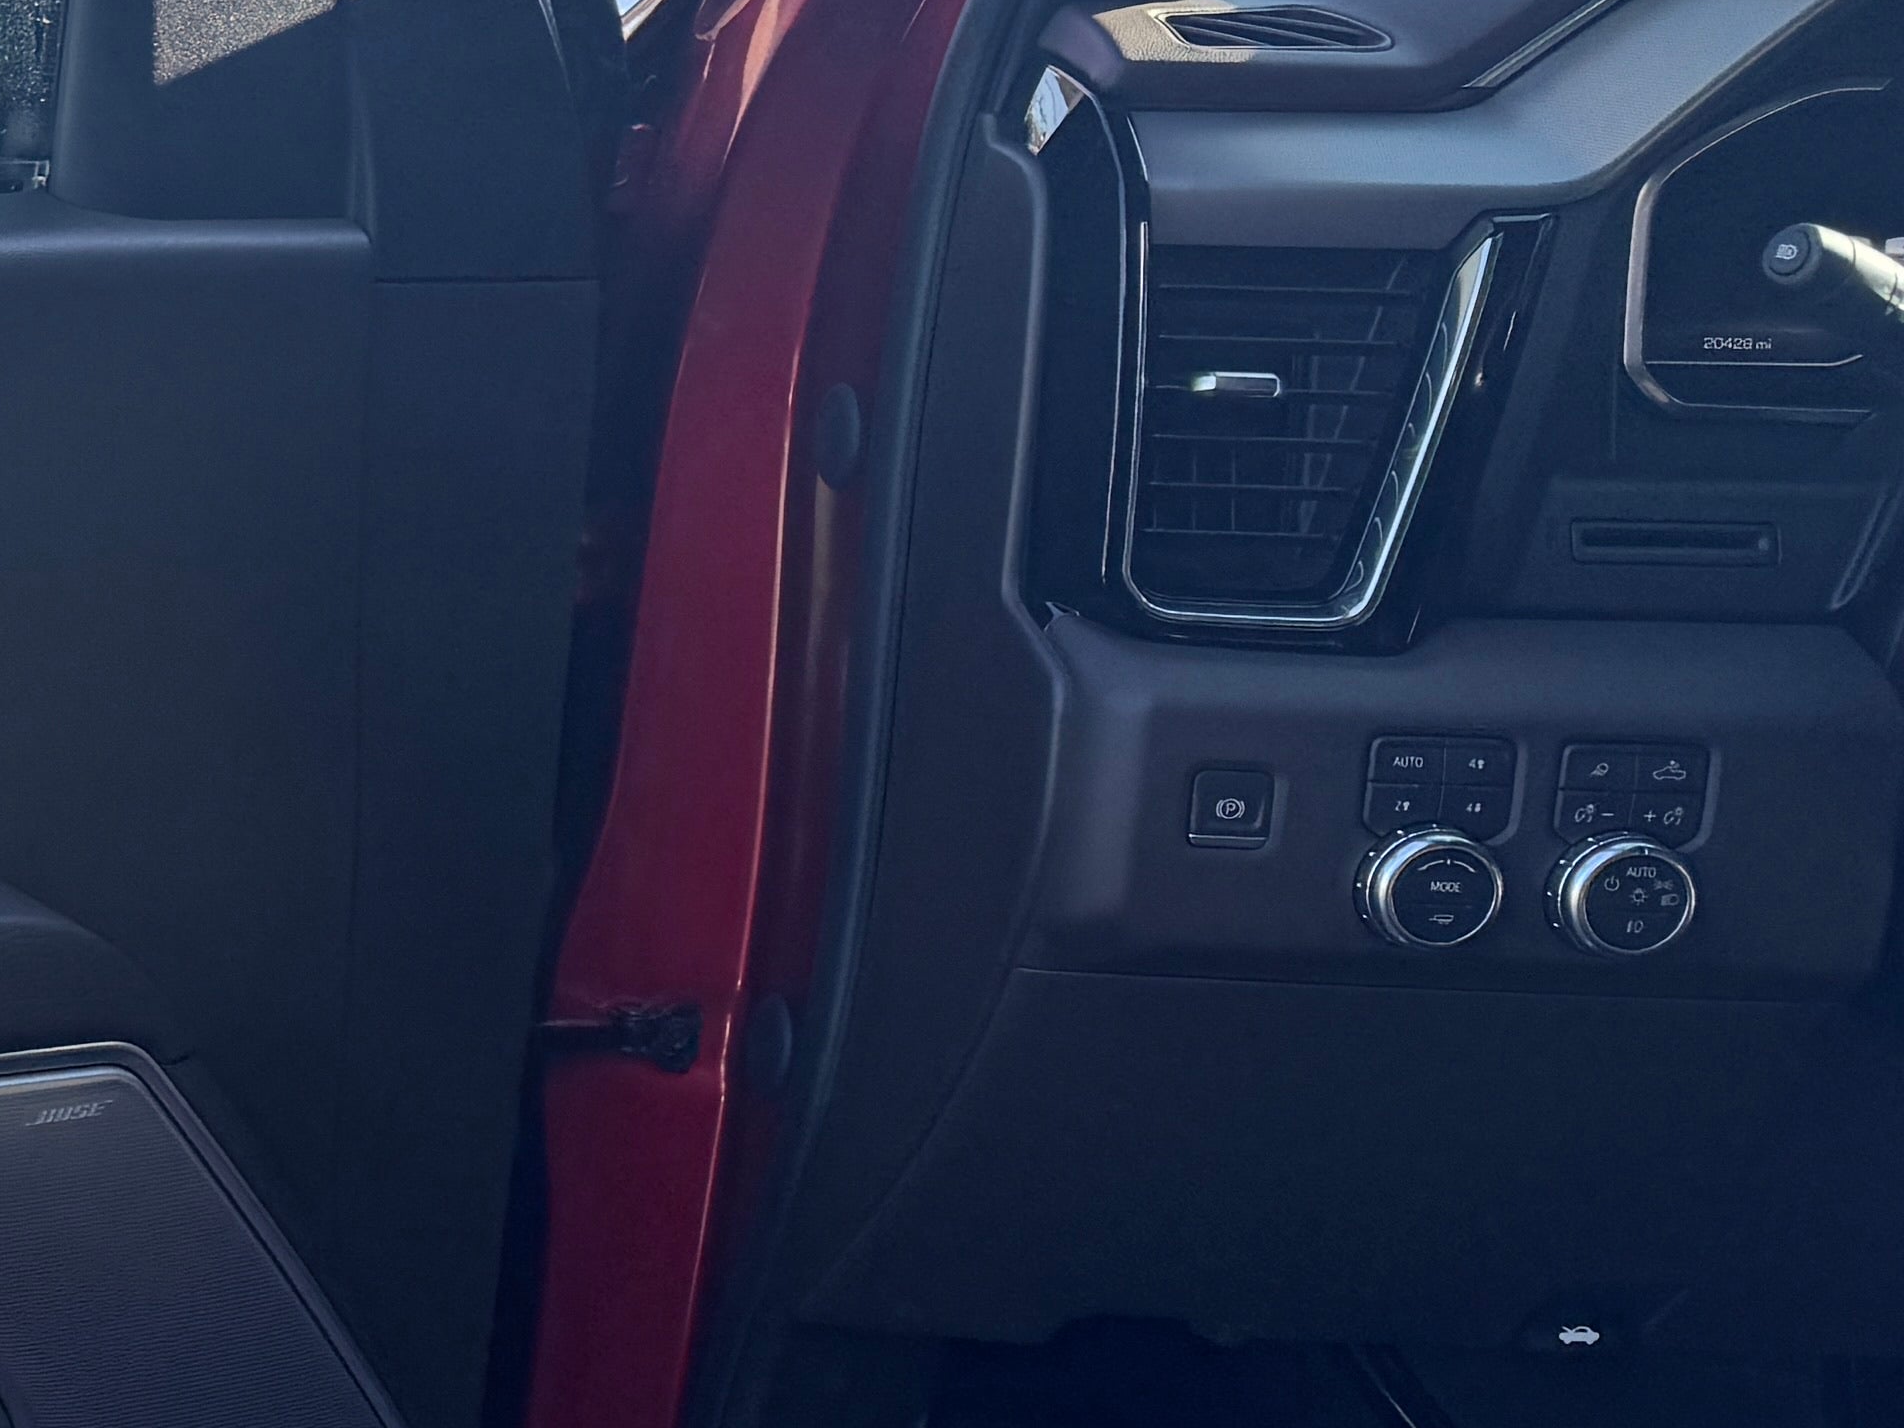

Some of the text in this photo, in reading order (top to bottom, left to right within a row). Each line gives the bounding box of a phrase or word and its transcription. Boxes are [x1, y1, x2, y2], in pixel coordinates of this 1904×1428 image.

[1755, 338, 1772, 350] mi
[1392, 755, 1425, 769] AUTO
[1626, 866, 1658, 878] AUTO
[1430, 880, 1463, 893] MODE
[25, 1099, 114, 1127] BOSE
